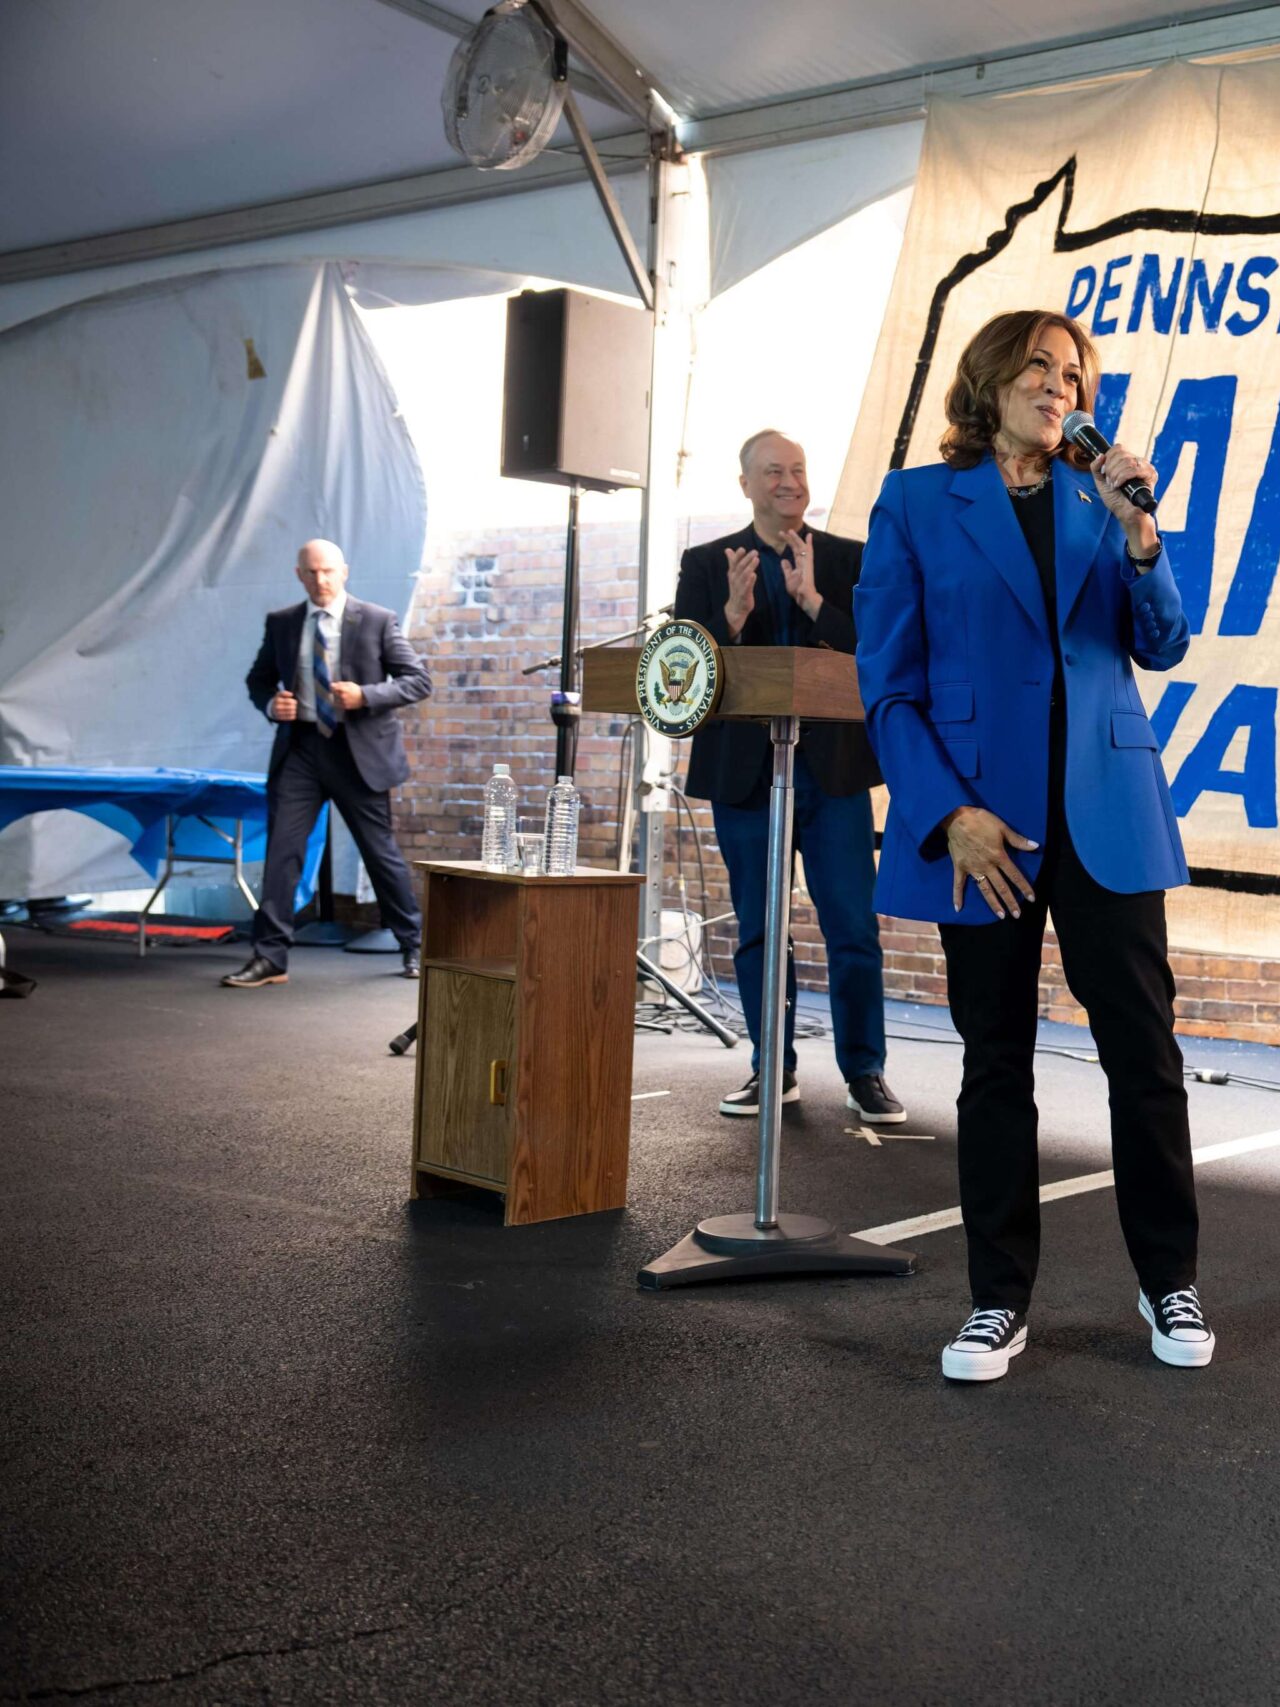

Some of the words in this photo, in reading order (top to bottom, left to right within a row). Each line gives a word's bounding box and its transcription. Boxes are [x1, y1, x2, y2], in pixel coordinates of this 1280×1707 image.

[665, 625, 676, 636] OF
[678, 625, 693, 637] THE
[638, 632, 662, 698] PRESIDENT
[695, 633, 715, 680] UNITED
[641, 702, 660, 729] VICE
[686, 687, 714, 729] STATES
